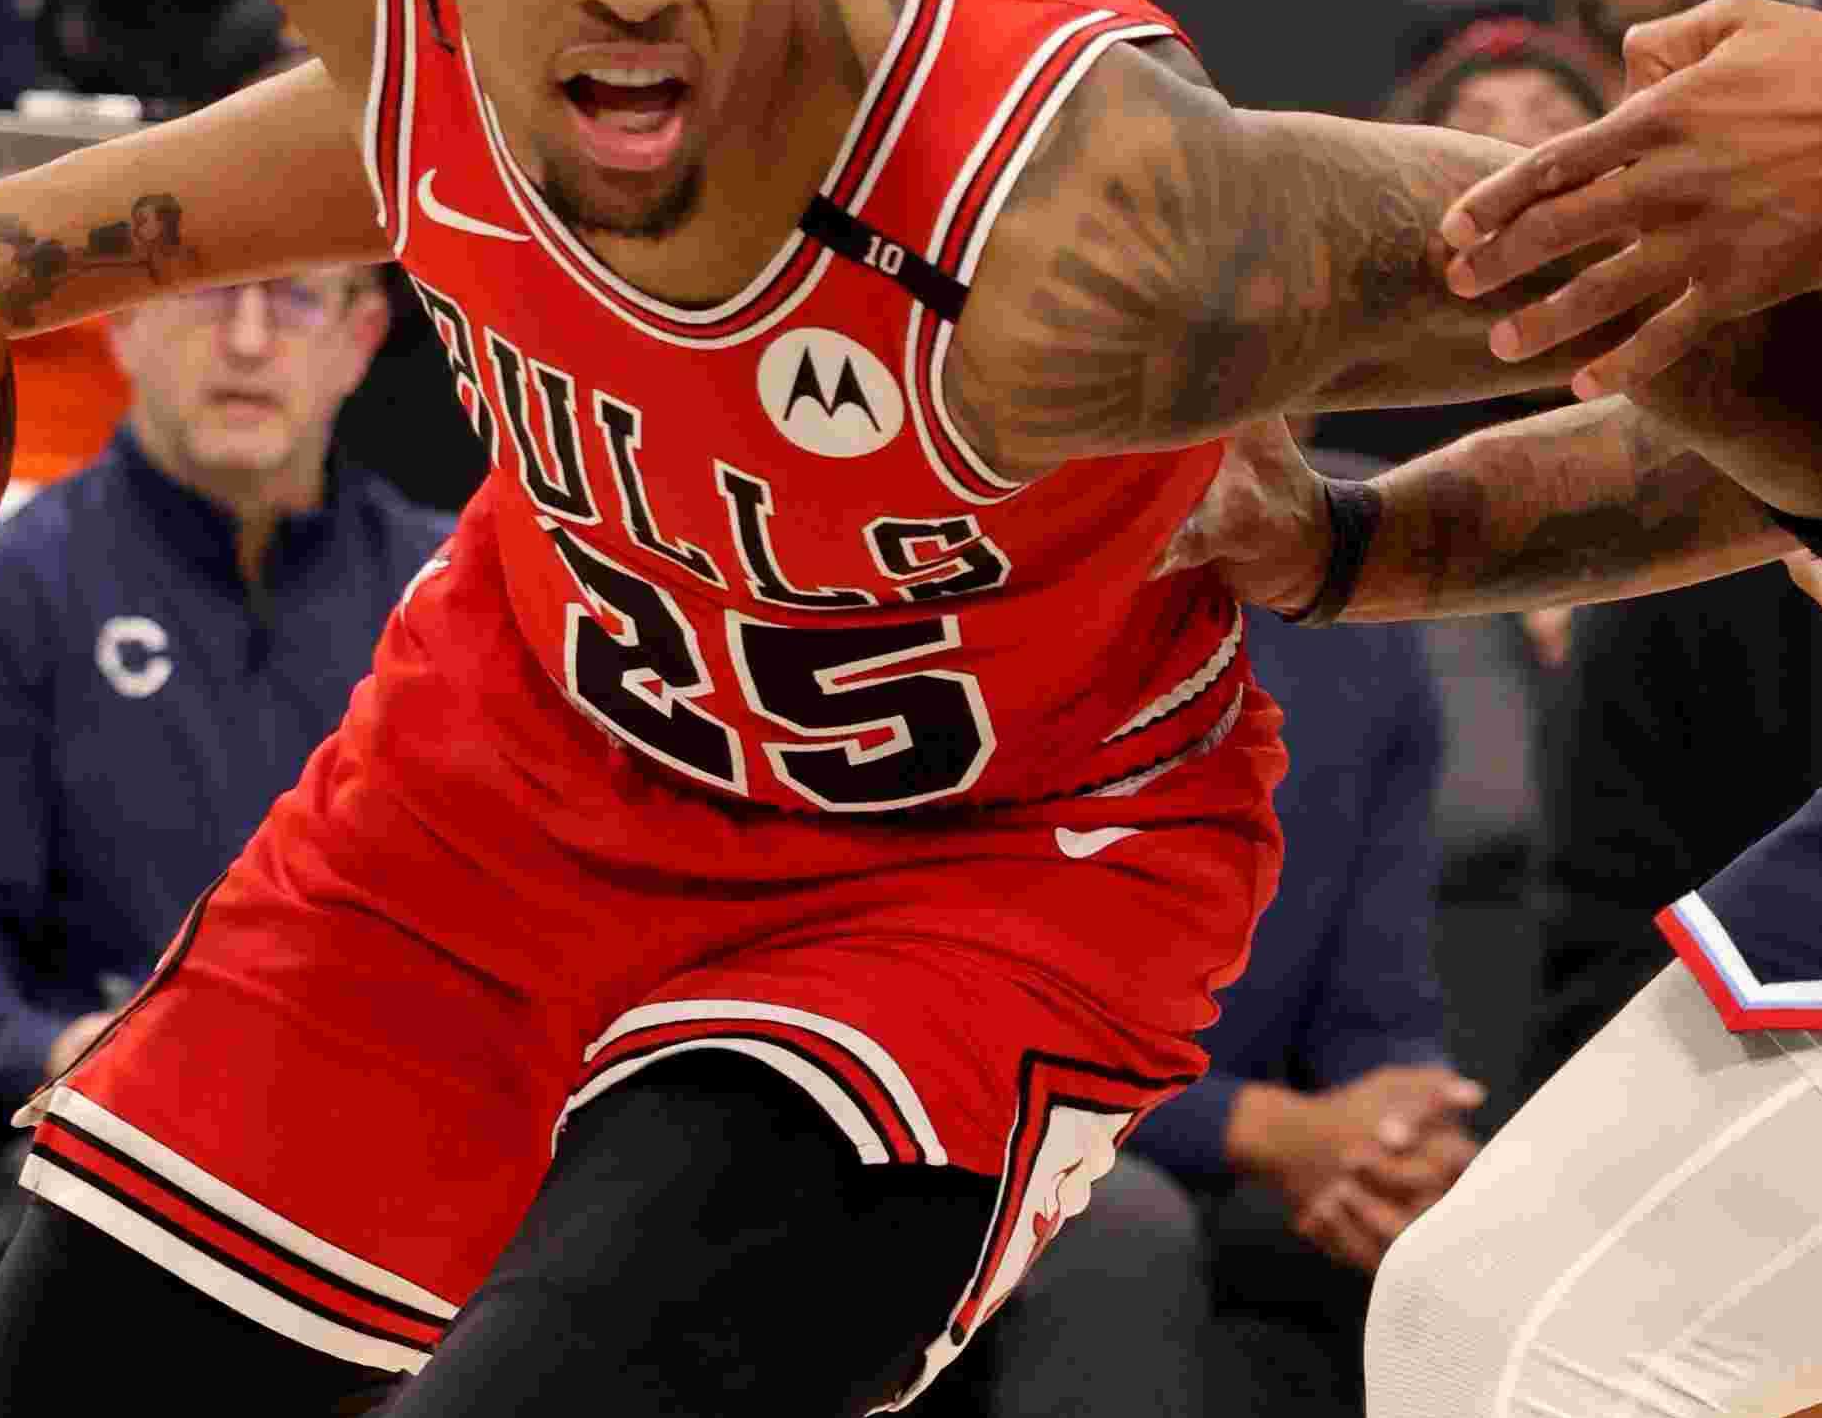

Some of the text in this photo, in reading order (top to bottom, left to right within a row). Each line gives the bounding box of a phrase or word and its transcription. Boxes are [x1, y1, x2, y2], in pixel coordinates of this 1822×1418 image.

[864, 236, 905, 276] 10
[409, 274, 1011, 610] BULLS
[535, 515, 998, 813] 25
